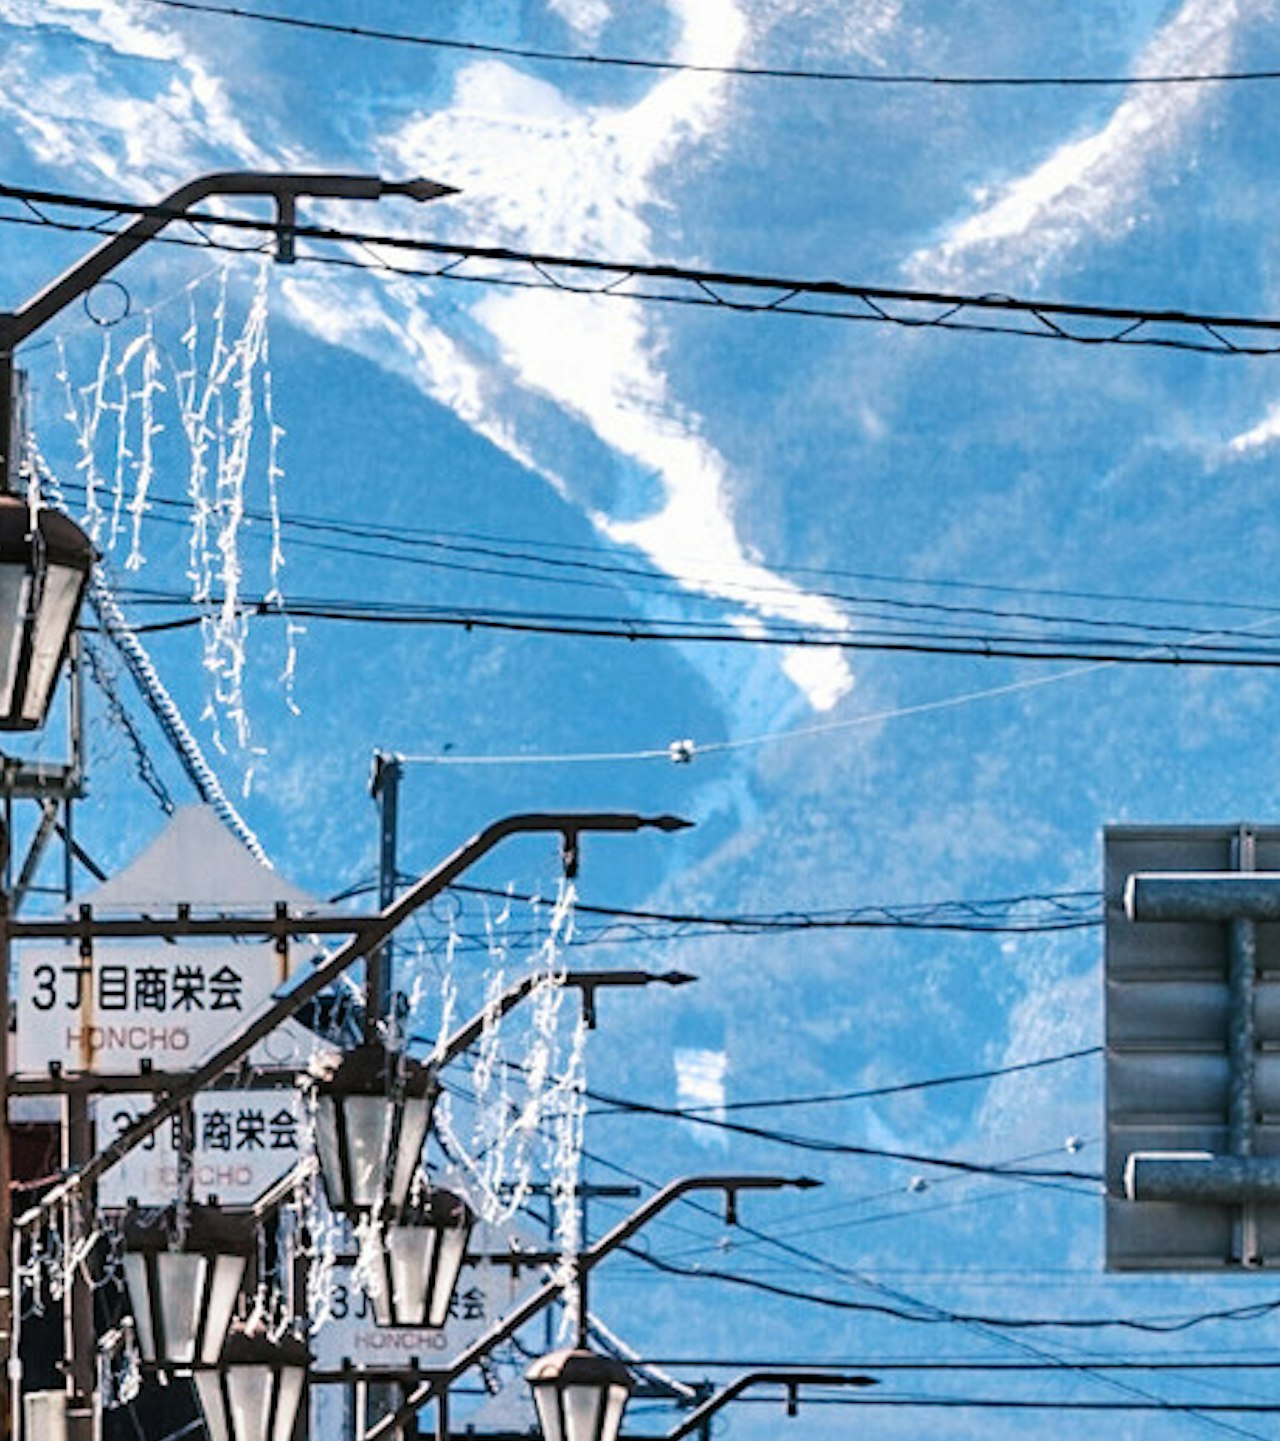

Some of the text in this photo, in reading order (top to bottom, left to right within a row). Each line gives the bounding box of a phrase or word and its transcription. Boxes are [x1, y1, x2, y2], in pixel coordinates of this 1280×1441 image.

[32, 964, 243, 1013] 3丁目商栄会
